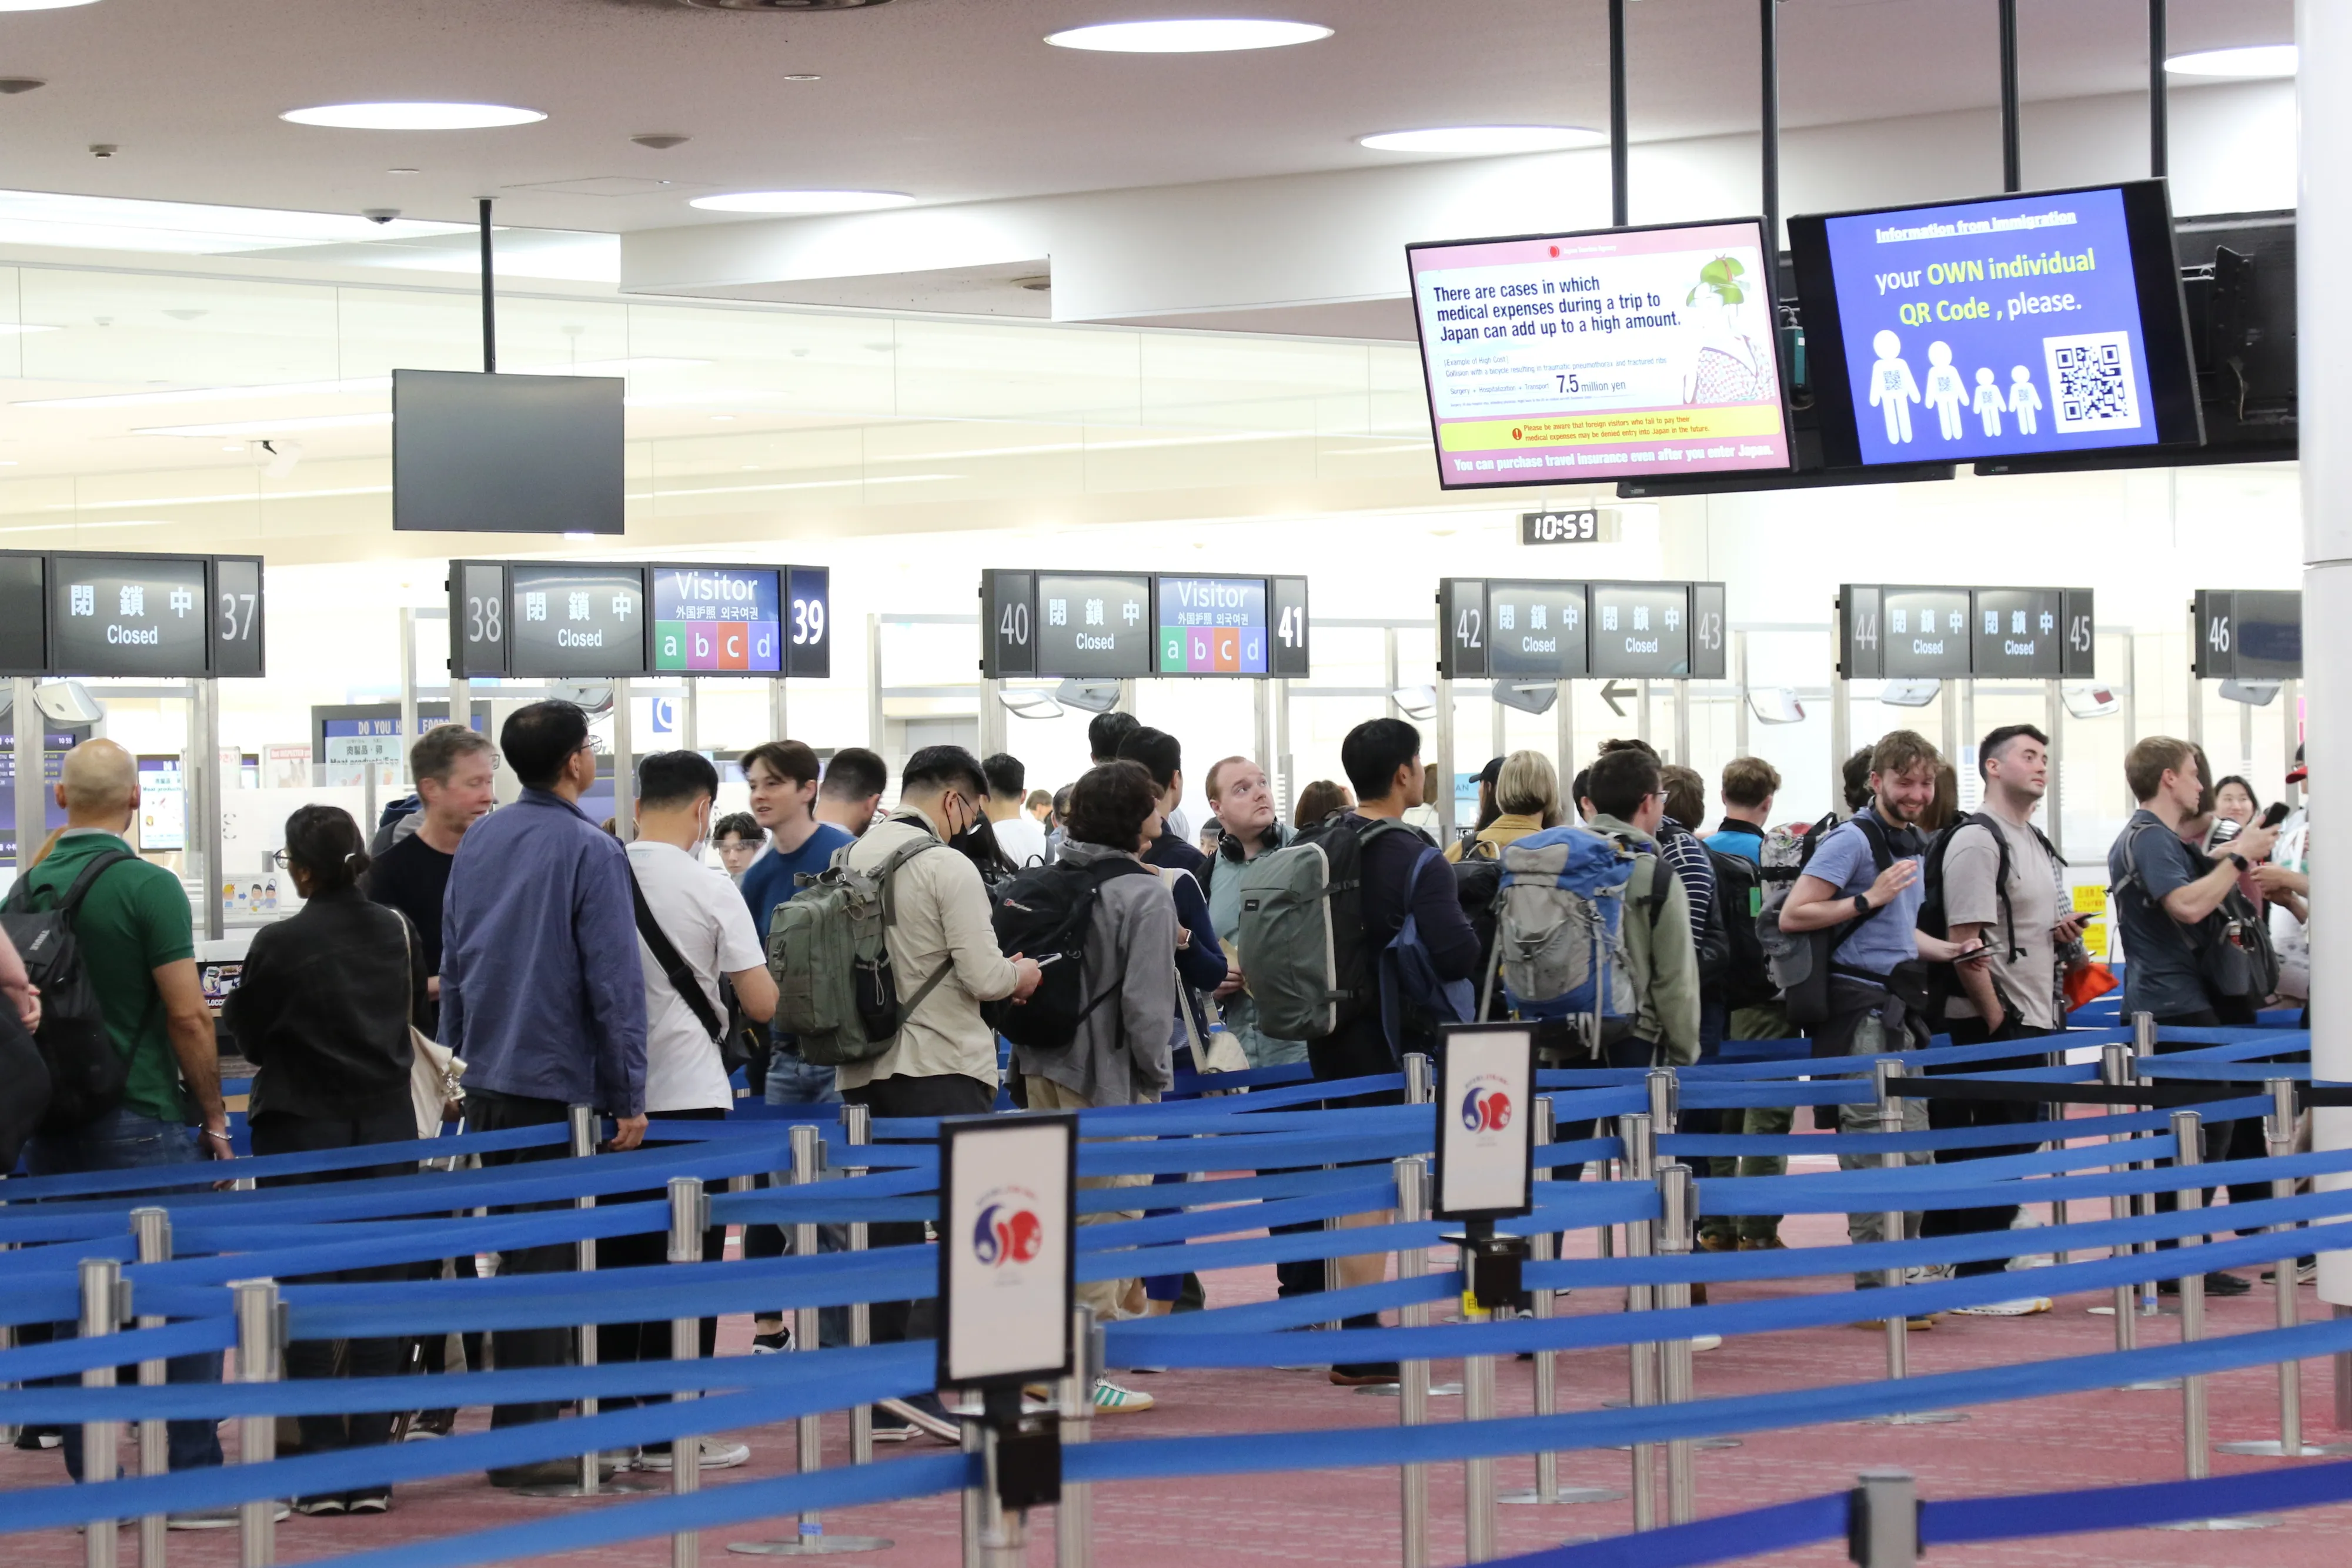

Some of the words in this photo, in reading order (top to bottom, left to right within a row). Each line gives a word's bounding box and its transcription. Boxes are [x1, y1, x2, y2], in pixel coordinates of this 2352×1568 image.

[1876, 223, 1955, 242] Information
[1957, 220, 1990, 235] from
[1875, 268, 1921, 295] your
[1927, 259, 1984, 286] OWN
[1989, 248, 2096, 279] individual
[1434, 286, 1471, 302] There
[1475, 286, 1496, 299] are
[1501, 283, 1538, 297] cases
[1542, 279, 1555, 295] in
[1559, 276, 1600, 293] which
[1437, 304, 1489, 322] medical
[1493, 302, 1554, 320] expenses
[1559, 297, 1602, 315] during
[1607, 297, 1614, 310] a
[1619, 293, 1643, 311] trip
[1647, 292, 1660, 306] to
[1900, 302, 1932, 326] QR
[1936, 297, 1990, 322] Code
[2007, 291, 2082, 320] please.
[1441, 326, 1479, 344] Japan
[1484, 325, 1507, 338] can
[1512, 320, 1536, 336] add
[1541, 322, 1556, 337] up
[1561, 319, 1574, 333] to
[1579, 320, 1586, 332] a
[1591, 315, 1621, 333] high
[1626, 311, 1681, 329] amount.
[1446, 369, 1469, 377] Collision
[1489, 367, 1509, 375] bicycle
[1511, 365, 1535, 373] resulting
[1572, 360, 1613, 370] pneumothorax
[1479, 356, 1491, 365] High
[1479, 385, 1516, 393] Hospitalization
[1556, 374, 1579, 393] 7.5
[1581, 381, 1608, 392] million
[1611, 381, 1626, 392] yen
[1525, 433, 1548, 442] medical
[1550, 432, 1576, 441] expenses
[1652, 427, 1670, 436] Japan
[1586, 421, 1606, 429] foreign
[1608, 419, 1629, 427] visitors
[1454, 459, 1474, 471] You
[1475, 459, 1494, 471] can
[1496, 456, 1543, 472] purchase
[1545, 453, 1575, 466] travel
[1576, 452, 1628, 465] insurance
[1631, 451, 1655, 463] even
[1658, 447, 1683, 461] after
[1685, 449, 1705, 462] you
[1708, 445, 1735, 458] enter
[1738, 444, 1774, 459] Japan.
[1535, 513, 1594, 540] 10:59
[675, 571, 758, 601] Visitor
[1177, 580, 1248, 609] Visitor
[71, 584, 192, 618] 閉鎖中
[526, 591, 632, 622] 閉鎖中
[676, 605, 716, 620] 外国护照
[721, 606, 759, 620] 외국여권
[1049, 598, 1140, 627] 閉鎖中
[221, 593, 256, 641] 37
[469, 596, 502, 643] 38
[793, 599, 824, 645] 39
[1000, 603, 1028, 646] 40
[1178, 611, 1213, 625] 外国护照
[1216, 612, 1248, 626] 외국여권
[1278, 606, 1303, 648] 41
[1456, 608, 1481, 648] 42
[1499, 604, 1578, 631] 閉鎖中
[1603, 606, 1679, 632] 閉鎖中
[1892, 609, 1963, 634] 閉鎖中
[1984, 610, 2053, 636] 閉鎖中
[106, 624, 158, 645] Closed
[557, 628, 602, 647] Closed
[1076, 631, 1114, 650] Closed
[1699, 612, 1721, 650] 43
[1855, 613, 1877, 651] 44
[2070, 615, 2090, 652] 45
[2209, 616, 2230, 653] 46
[664, 635, 677, 656] a
[696, 633, 709, 657] b
[727, 635, 739, 658] c
[757, 633, 770, 658] d
[1167, 639, 1178, 659] a
[1194, 638, 1206, 660] b
[1220, 639, 1232, 661] c
[1247, 637, 1258, 660] d
[1522, 636, 1556, 653] Closed
[1625, 637, 1658, 653] Closed
[1913, 639, 1943, 654] Closed
[2004, 640, 2034, 656] Closed
[358, 721, 370, 735] DO
[374, 720, 391, 734] YOU
